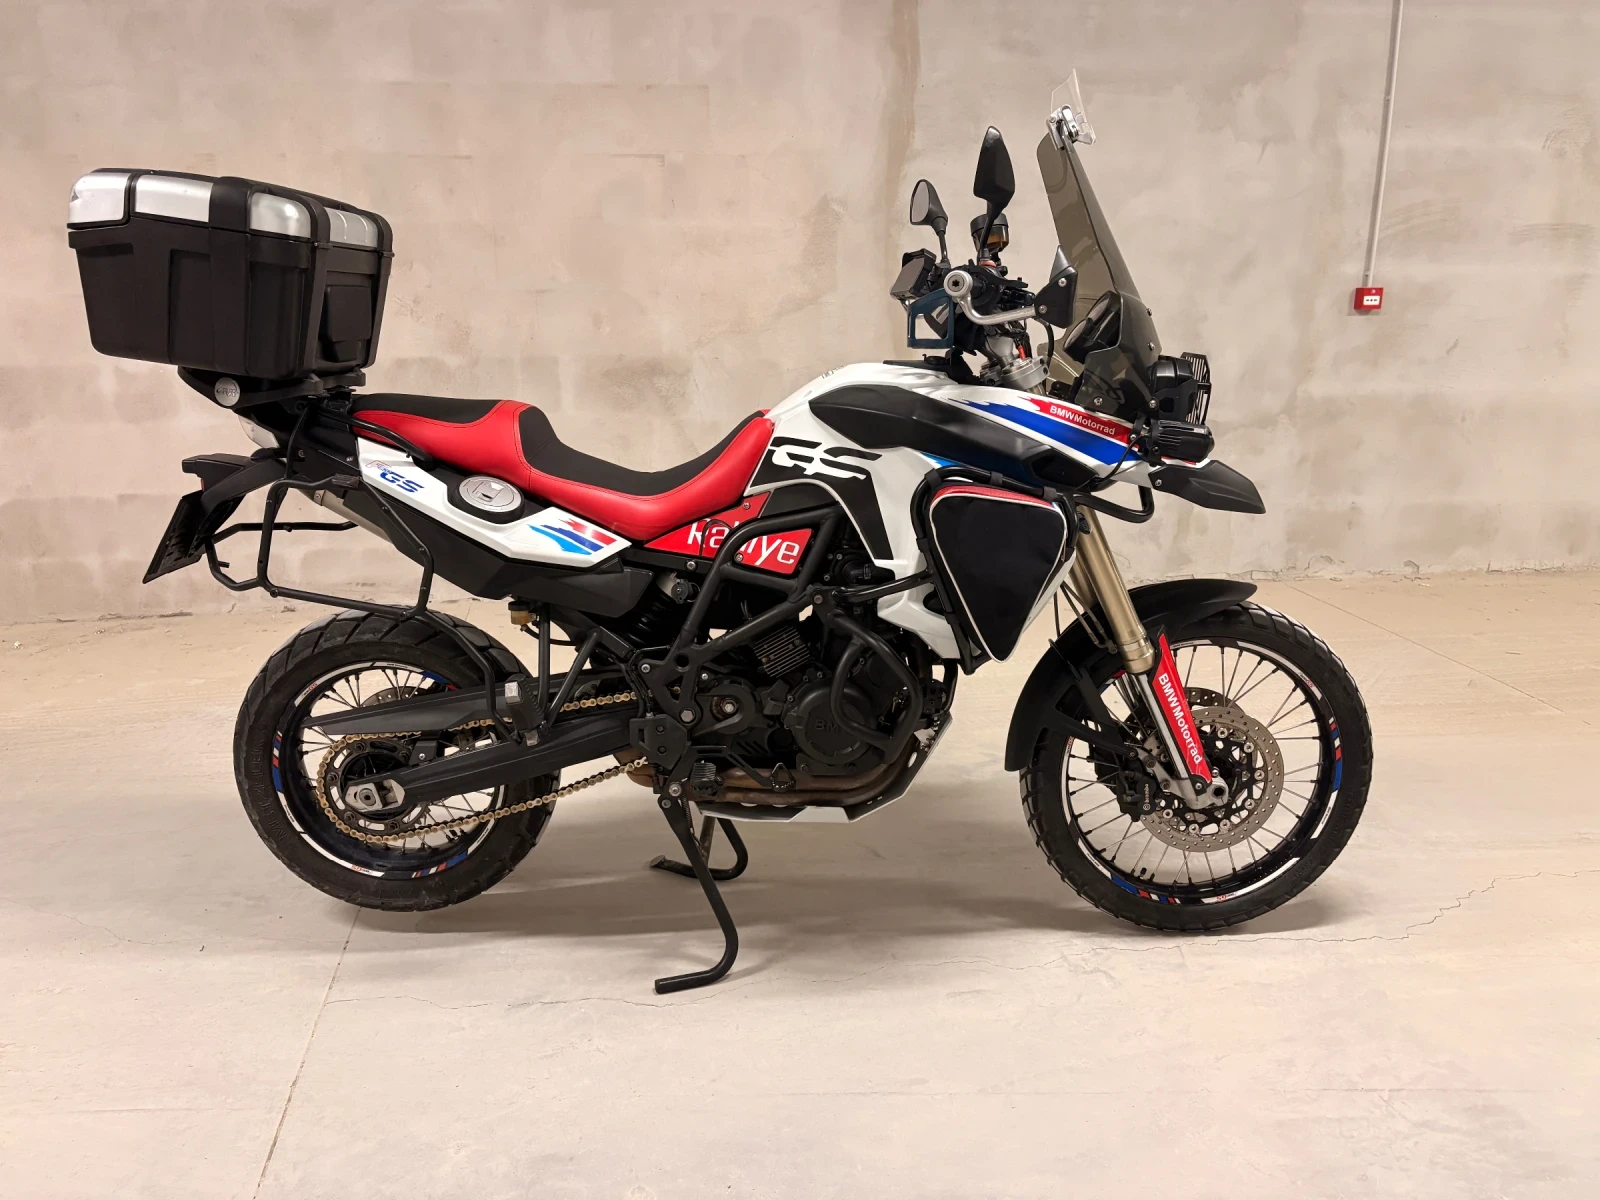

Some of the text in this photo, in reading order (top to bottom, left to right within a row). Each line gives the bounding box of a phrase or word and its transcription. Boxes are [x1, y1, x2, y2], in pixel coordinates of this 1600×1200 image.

[1049, 405, 1116, 436] BMWMotorrad
[769, 436, 882, 480] GS
[380, 471, 425, 493] GS
[1158, 672, 1203, 765] BMWMotorrad
